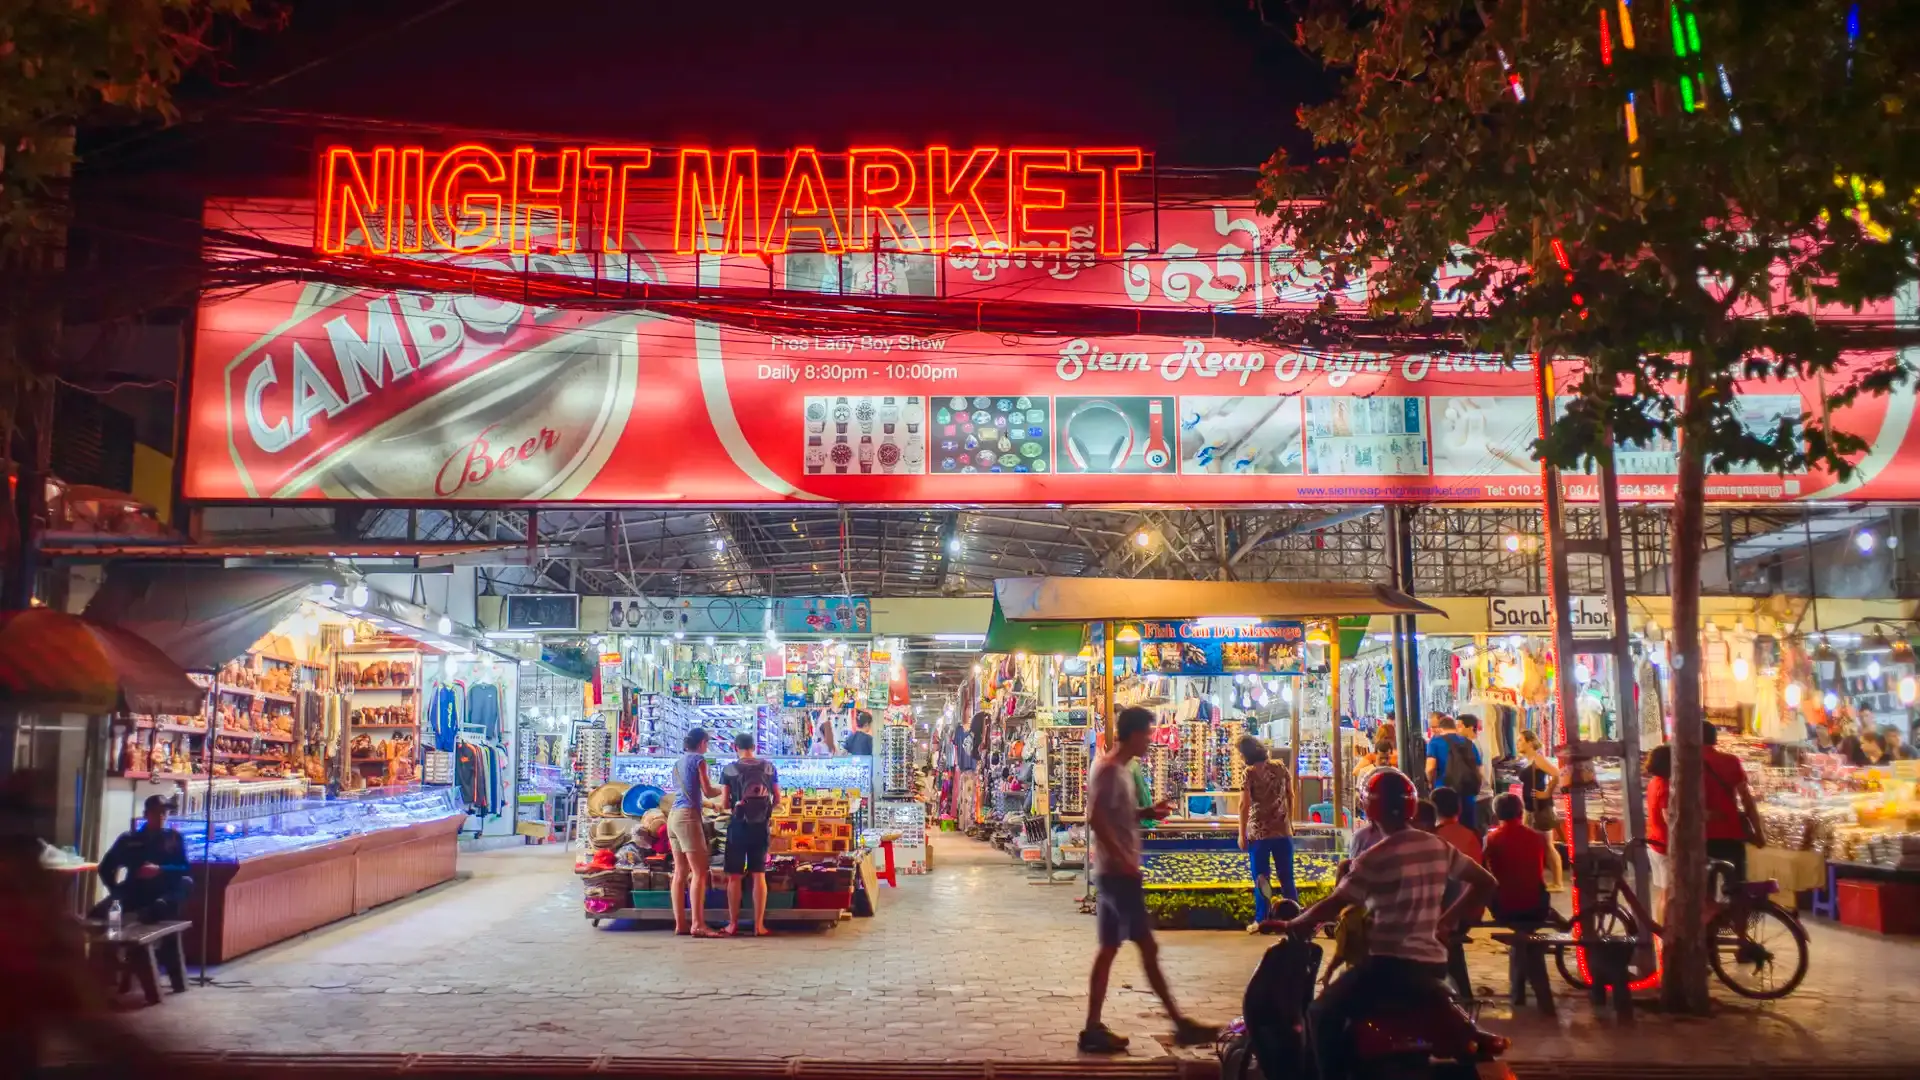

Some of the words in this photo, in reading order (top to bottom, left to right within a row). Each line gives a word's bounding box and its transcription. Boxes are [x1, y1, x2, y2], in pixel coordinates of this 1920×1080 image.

[321, 144, 651, 255] NIGHT
[674, 146, 1144, 256] MARKET
[771, 336, 808, 351] Free
[815, 335, 854, 353] Lady
[861, 336, 892, 354] Boy
[898, 335, 945, 351] Show
[1056, 339, 1151, 381] Siem
[1160, 340, 1265, 387] Reap
[757, 364, 800, 383] Daily
[805, 364, 868, 382] 8:30pm
[885, 364, 958, 382] 10:00pm
[435, 424, 562, 498] Beer
[1508, 485, 1530, 496] 010
[1143, 623, 1176, 638] Fish
[1179, 623, 1210, 638] Can
[1213, 624, 1235, 638] Do
[1238, 624, 1302, 641] Massage
